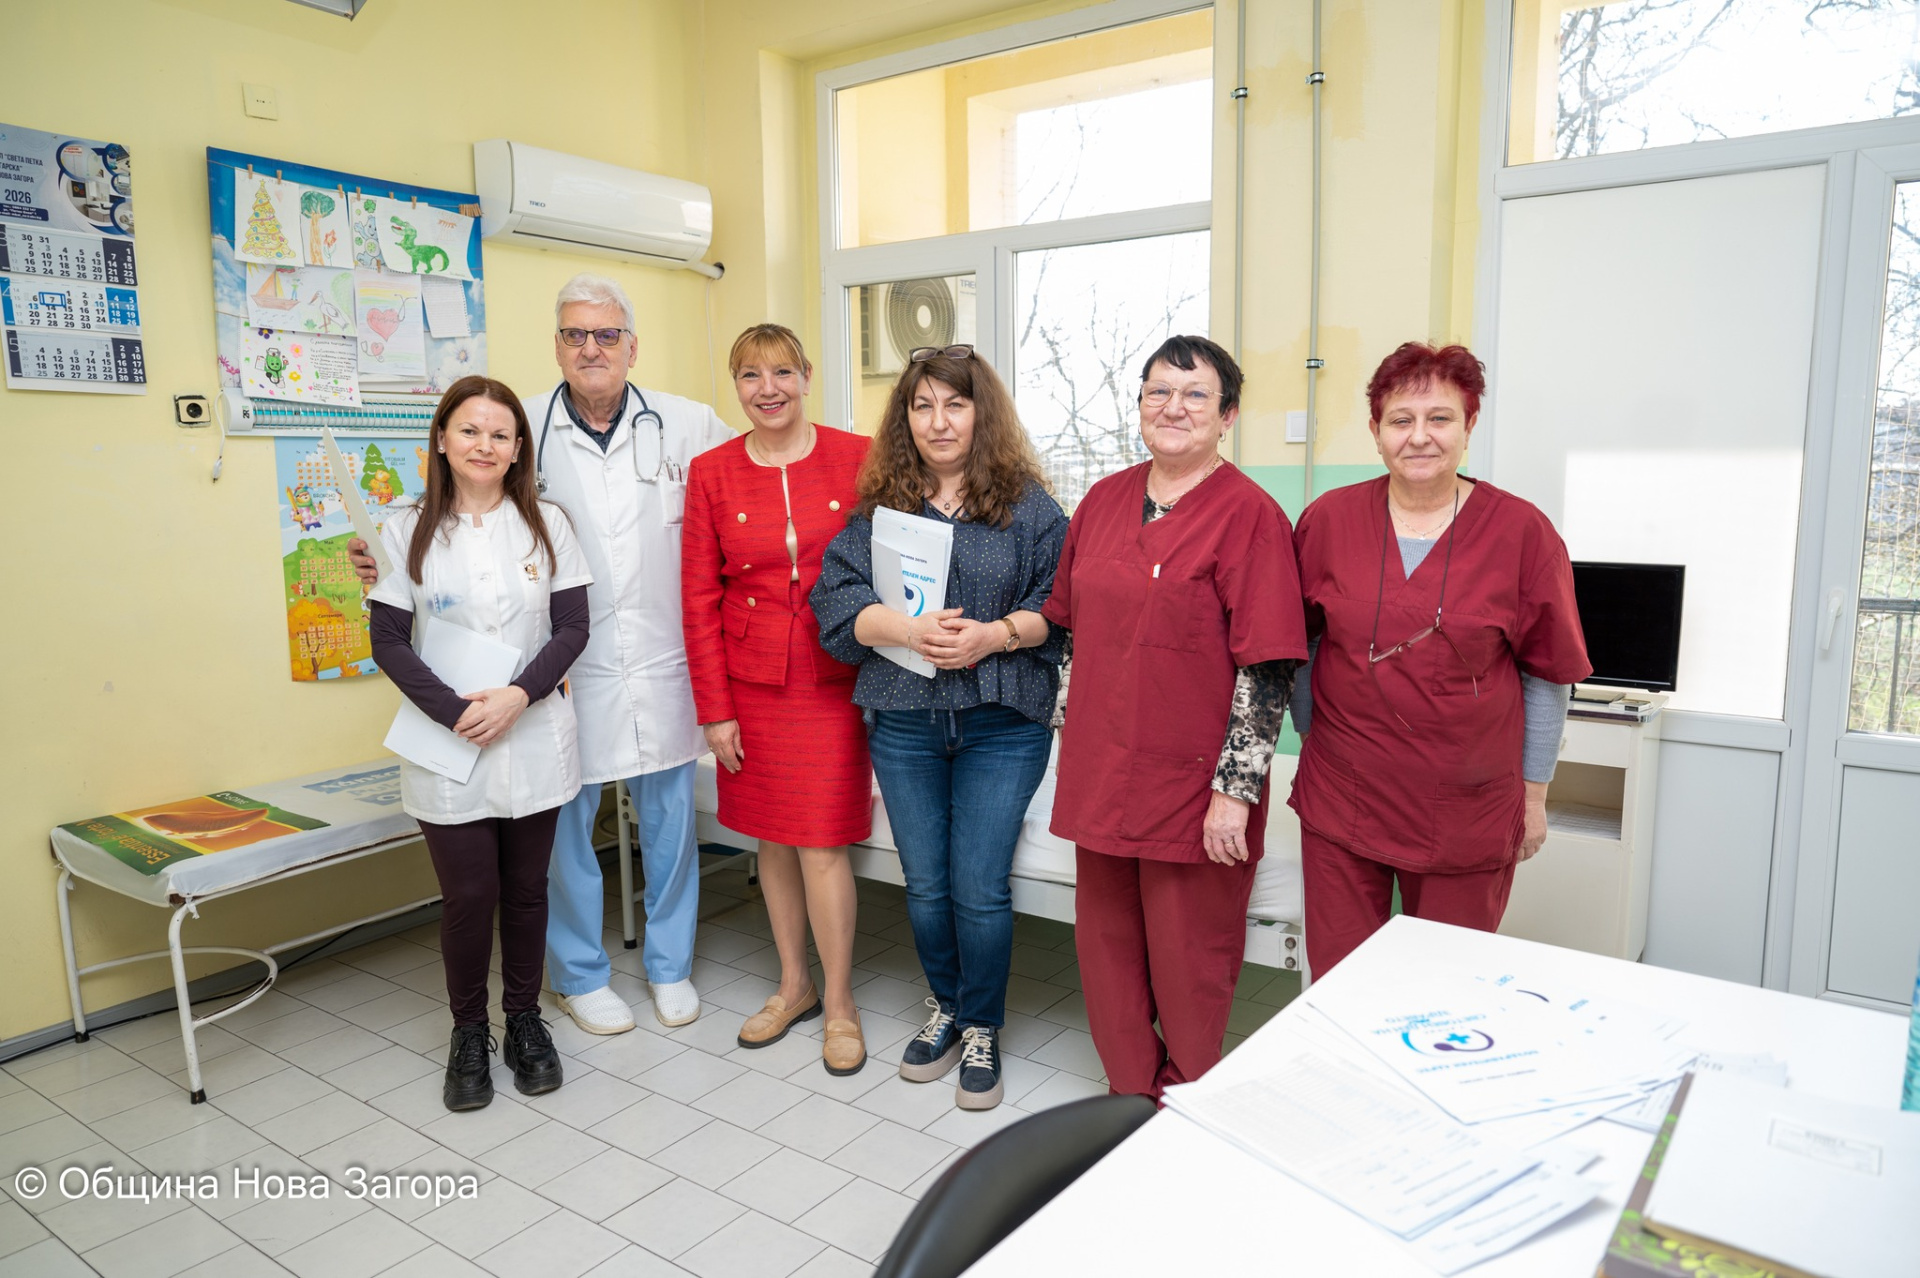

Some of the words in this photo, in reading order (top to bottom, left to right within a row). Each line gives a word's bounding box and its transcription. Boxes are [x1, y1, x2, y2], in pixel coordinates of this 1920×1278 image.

[26, 156, 43, 166] ПЕТКА
[13, 174, 34, 184] ЗАГОРА
[4, 188, 32, 204] 2026
[960, 279, 976, 289] TRE
[9, 338, 19, 352] 5
[920, 575, 936, 584] АДРЕС
